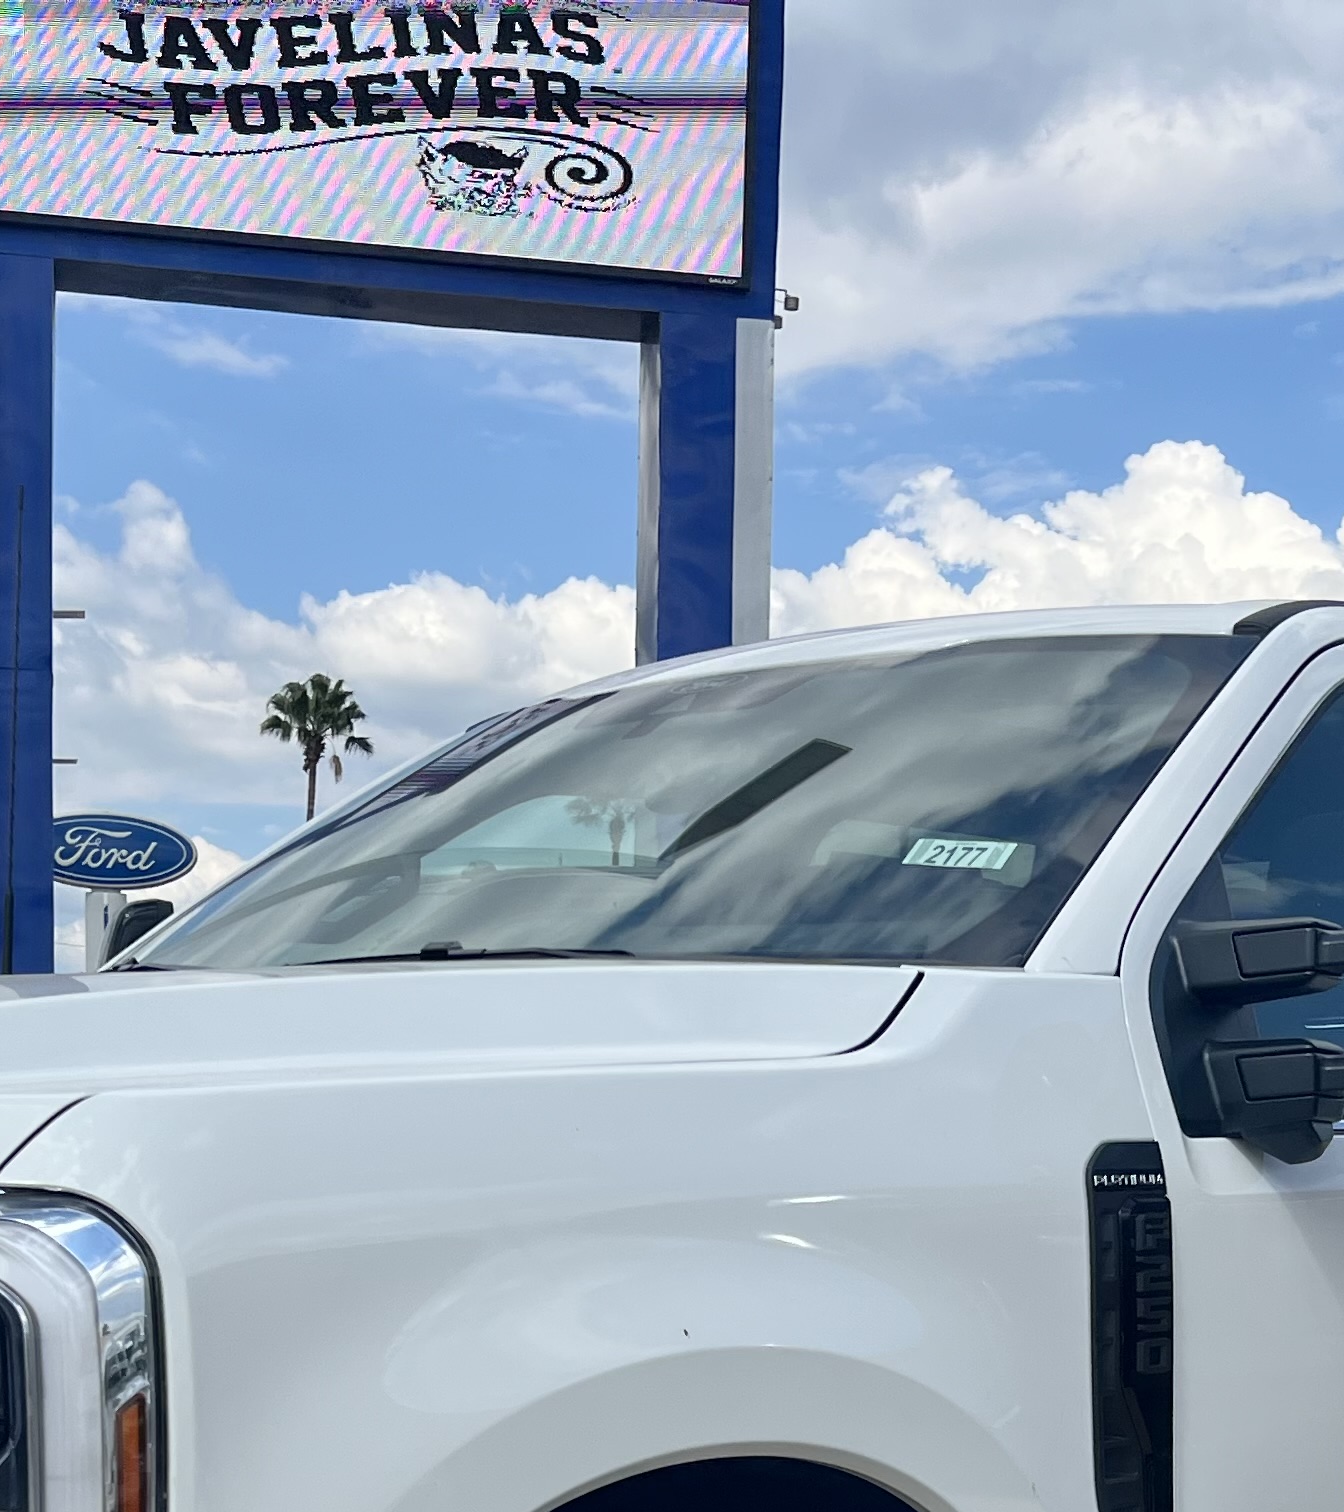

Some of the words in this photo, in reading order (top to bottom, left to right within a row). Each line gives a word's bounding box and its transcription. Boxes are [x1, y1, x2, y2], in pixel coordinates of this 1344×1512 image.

[99, 8, 605, 71] JAVELINAS
[163, 66, 585, 135] FOREVER
[54, 826, 158, 871] Ford
[923, 844, 989, 867] 2177
